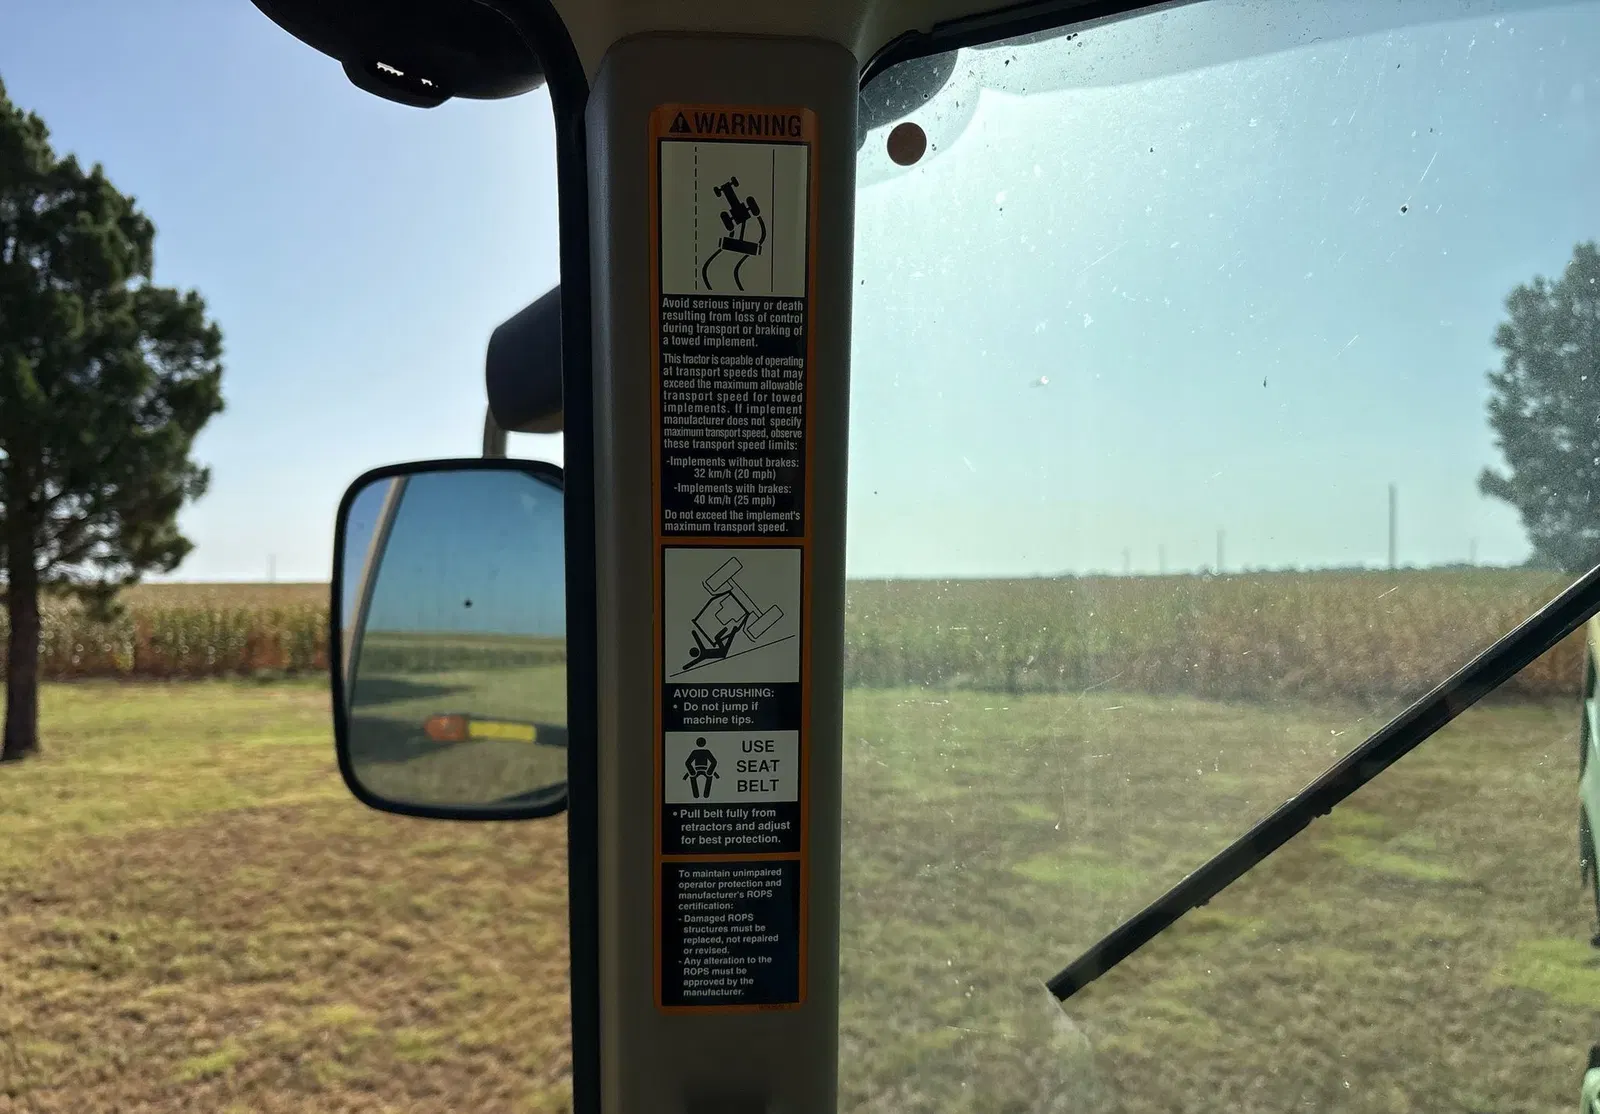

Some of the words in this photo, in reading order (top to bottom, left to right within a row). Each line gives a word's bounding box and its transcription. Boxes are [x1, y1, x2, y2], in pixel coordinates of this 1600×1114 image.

[694, 112, 801, 137] WARNING
[663, 298, 689, 309] Avoid
[693, 299, 729, 309] serious
[732, 300, 760, 312] injury
[764, 302, 773, 310] or
[777, 301, 803, 311] death
[663, 310, 706, 323] resulting
[709, 311, 731, 322] from
[735, 312, 754, 322] loss
[758, 313, 767, 322] of
[770, 313, 803, 323] control
[663, 323, 693, 334] during
[696, 324, 740, 336] transport
[743, 326, 752, 334] or
[756, 325, 790, 337] braking
[794, 326, 803, 336] of
[663, 337, 668, 345] a
[672, 336, 700, 346] towed
[704, 336, 758, 348] implement.
[663, 353, 681, 364] This
[683, 354, 709, 364] tractor
[712, 354, 719, 364] is
[720, 355, 753, 366] capable
[755, 356, 764, 366] of
[765, 356, 803, 368] operating
[663, 366, 673, 376] at
[676, 367, 720, 378] transport
[724, 368, 758, 379] speeds
[761, 368, 780, 378] that
[783, 370, 803, 380] may
[663, 379, 695, 388] exceed
[697, 379, 711, 388] the
[714, 380, 758, 389] maximum
[761, 380, 803, 390] allowable
[663, 390, 713, 402] transport
[717, 392, 748, 403] speed
[753, 392, 767, 402] for
[772, 392, 802, 402] towed
[664, 402, 730, 414] implements.
[735, 404, 742, 413] If
[747, 404, 802, 415] implement
[664, 415, 724, 425] manufacturer
[727, 416, 748, 425] does
[751, 416, 765, 426] not
[770, 416, 801, 428] specify
[664, 427, 704, 436] maximum
[705, 428, 740, 439] transport
[742, 428, 768, 439] speed,
[771, 428, 802, 438] observe
[664, 439, 689, 448] these
[693, 439, 734, 450] transport
[738, 440, 765, 451] speed
[768, 440, 797, 450] limits:
[728, 457, 763, 467] without
[766, 458, 799, 467] brakes:
[694, 468, 705, 478] 32
[708, 469, 731, 479] km/h
[734, 469, 749, 480] (20
[752, 469, 776, 480] mph)
[736, 483, 755, 493] with
[759, 484, 791, 493] brakes:
[694, 495, 705, 505] 40
[708, 495, 731, 506] km/h
[734, 495, 749, 506] (25
[752, 495, 775, 507] mph)
[665, 509, 677, 519] Do
[680, 510, 693, 519] not
[696, 510, 727, 520] exceed
[730, 510, 743, 520] the
[746, 511, 800, 521] implement's
[665, 522, 711, 531] maximum
[714, 522, 755, 533] transport
[758, 522, 788, 534] speed.
[673, 689, 709, 698] AVOID
[712, 688, 774, 698] CRUSHING:
[684, 702, 698, 711] Do
[702, 702, 719, 711] not
[722, 702, 748, 713] jump
[752, 701, 758, 711] if
[683, 715, 728, 724] machine
[731, 715, 754, 725] tips.
[742, 740, 774, 753] USE
[736, 759, 780, 773] SEAT
[737, 779, 779, 792] BELT
[680, 810, 700, 818] Pull
[704, 809, 723, 818] belt
[726, 809, 749, 819] fully
[752, 808, 776, 817] from
[681, 822, 733, 831] retractors
[735, 822, 755, 831] and
[758, 821, 790, 832] adjust
[681, 836, 696, 845] for
[699, 835, 722, 844] best
[725, 834, 781, 846] protection.
[679, 870, 690, 878] To
[693, 870, 730, 878] maintain
[733, 868, 781, 878] unimpaired
[678, 881, 716, 890] operator
[718, 880, 763, 889] protection
[765, 879, 781, 887] and
[679, 891, 744, 899] manufacturer's
[747, 890, 773, 898] ROPS
[679, 902, 734, 910] certification:
[684, 914, 725, 924] Damaged
[728, 914, 754, 922] ROPS
[684, 925, 728, 933] structures
[755, 924, 766, 932] be
[684, 936, 724, 945] replaced,
[743, 934, 779, 944] repaired
[695, 946, 729, 954] revised.
[684, 958, 701, 966] Any
[704, 957, 745, 965] alteration
[684, 968, 709, 976] ROPS
[683, 978, 724, 987] approved
[727, 978, 738, 987] by
[684, 988, 744, 996] manufacturer.
